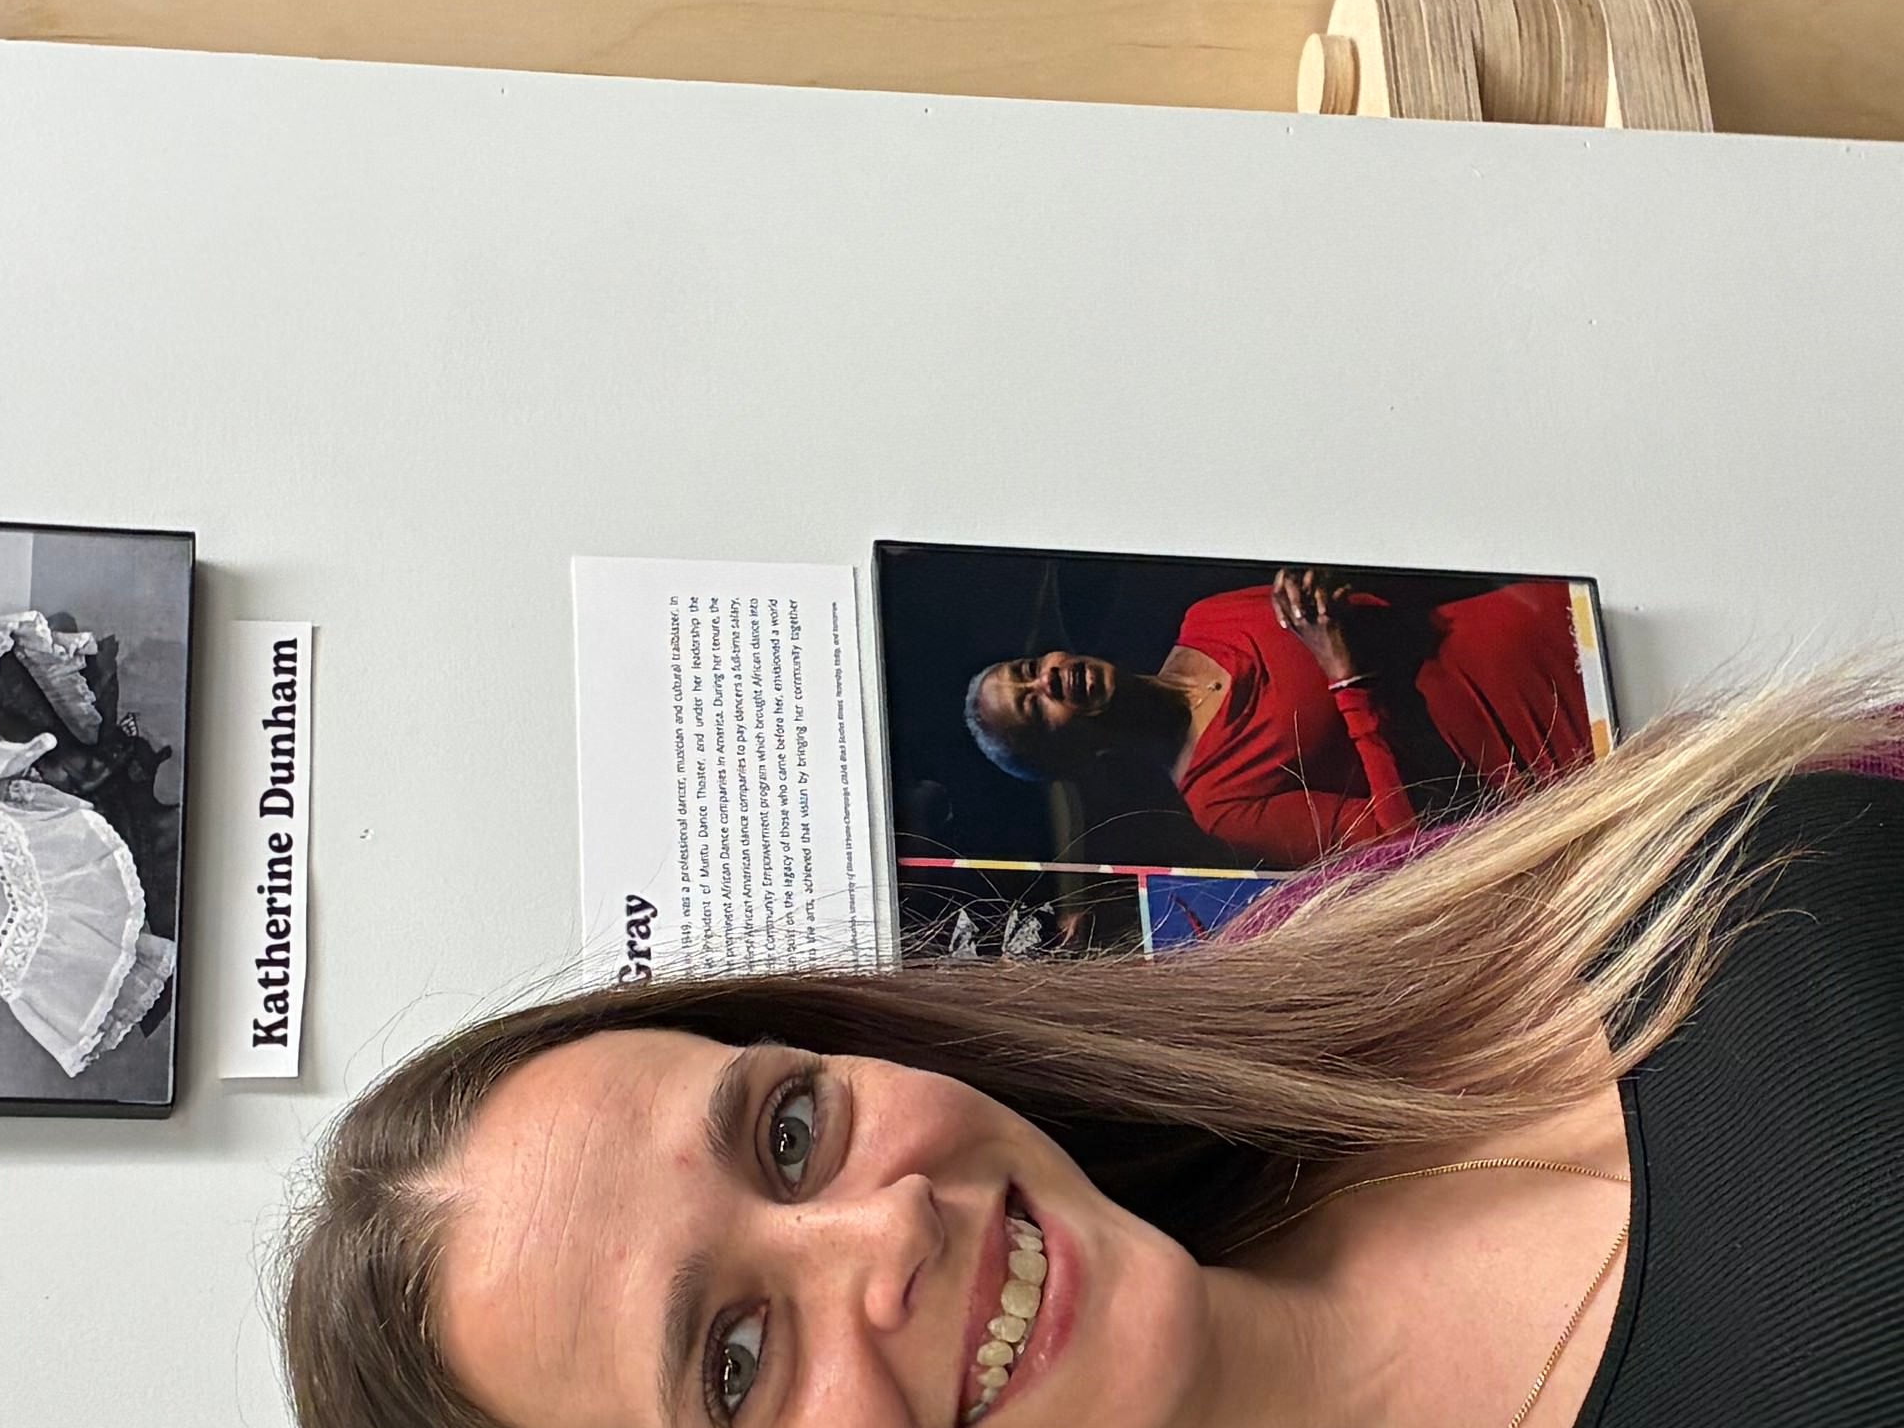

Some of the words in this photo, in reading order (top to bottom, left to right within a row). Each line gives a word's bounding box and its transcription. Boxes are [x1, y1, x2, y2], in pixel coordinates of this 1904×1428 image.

[689, 596, 700, 613] the
[709, 598, 720, 613] the
[768, 599, 780, 627] world
[788, 600, 803, 641] together
[689, 618, 704, 670] leadership
[749, 620, 761, 650] dance
[711, 654, 722, 671] her
[751, 653, 763, 688] African
[790, 645, 805, 700] community
[671, 665, 683, 702] cultural
[691, 676, 703, 692] her
[712, 674, 726, 707] During
[672, 706, 684, 725] and
[692, 697, 704, 727] under
[733, 683, 745, 722] dancers
[752, 690, 767, 730] brought
[793, 705, 805, 722] her
[259, 637, 298, 819] Dunham
[693, 734, 705, 752] and
[736, 725, 748, 743] pay
[773, 718, 786, 750] before
[673, 729, 685, 773] musician
[735, 745, 746, 756] to
[754, 732, 766, 762] which
[794, 726, 809, 767] bringing
[777, 754, 787, 781] came
[796, 772, 810, 784] by
[715, 769, 730, 824] companies
[736, 758, 751, 813] companies
[758, 765, 770, 809] program
[777, 785, 788, 807] who
[797, 789, 809, 818] vision
[696, 806, 708, 838] Dance
[738, 816, 750, 846] dance
[778, 810, 790, 838] those
[799, 823, 810, 844] that
[676, 819, 691, 882] professional
[718, 827, 730, 860] Dance
[758, 812, 774, 887] Empowerment
[779, 842, 791, 852] of
[719, 864, 731, 900] African
[739, 850, 752, 899] American
[780, 856, 794, 888] legacy
[800, 848, 813, 894] achieved
[699, 884, 710, 895] of
[782, 891, 793, 909] the
[681, 897, 690, 917] was
[761, 890, 777, 951] Community
[251, 831, 294, 1049] Katherine
[617, 894, 658, 983] Gray
